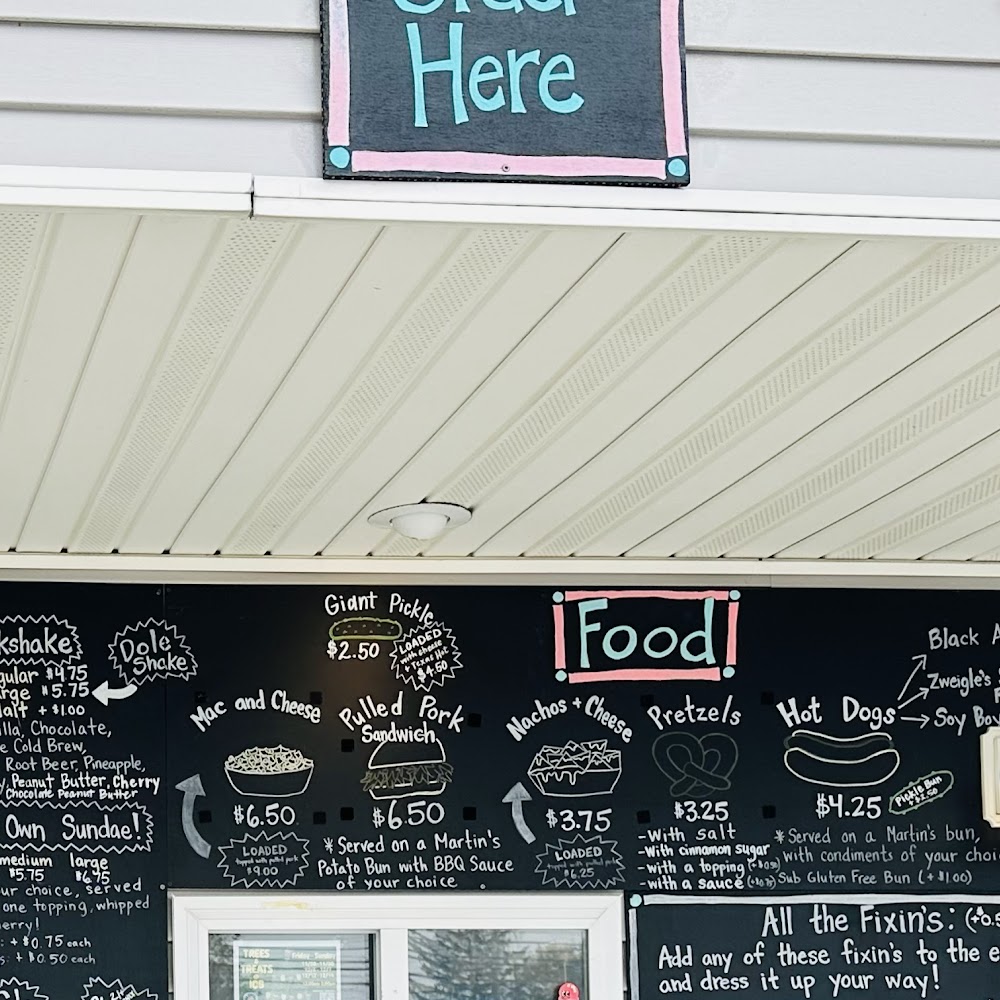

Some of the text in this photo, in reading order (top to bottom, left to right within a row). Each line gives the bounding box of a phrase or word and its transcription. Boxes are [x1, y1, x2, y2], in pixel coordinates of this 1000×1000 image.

[406, 23, 584, 127] Here
[325, 591, 434, 623] Giant Pickle
[578, 597, 716, 668] Food
[120, 634, 171, 660] Dole
[326, 640, 379, 660] $2.50
[133, 652, 188, 675] Shake
[190, 689, 320, 732] Mac and Cheese
[339, 691, 463, 732] Pulled Pork
[647, 695, 741, 730] Pretzels
[776, 696, 896, 730] Hot Dogs
[31, 719, 111, 737] Chocolate,
[361, 725, 435, 744] Sandwich
[14, 738, 41, 754] Cold
[47, 738, 86, 755] Brew,
[234, 803, 295, 828] $6.50
[373, 800, 444, 829] $6.50
[674, 801, 728, 822] $3.25
[816, 793, 881, 819] $4.25
[6, 814, 45, 841] Own
[62, 812, 141, 840] Sundae!
[243, 844, 287, 856] LOADED
[392, 840, 409, 852] on
[417, 840, 426, 850] a
[435, 829, 500, 850] Martin's
[318, 855, 514, 881] Potato Bun with BBQ Sauce
[762, 904, 955, 937] All the Fixin's:
[243, 949, 270, 958] TREES
[241, 965, 273, 974] TREATS
